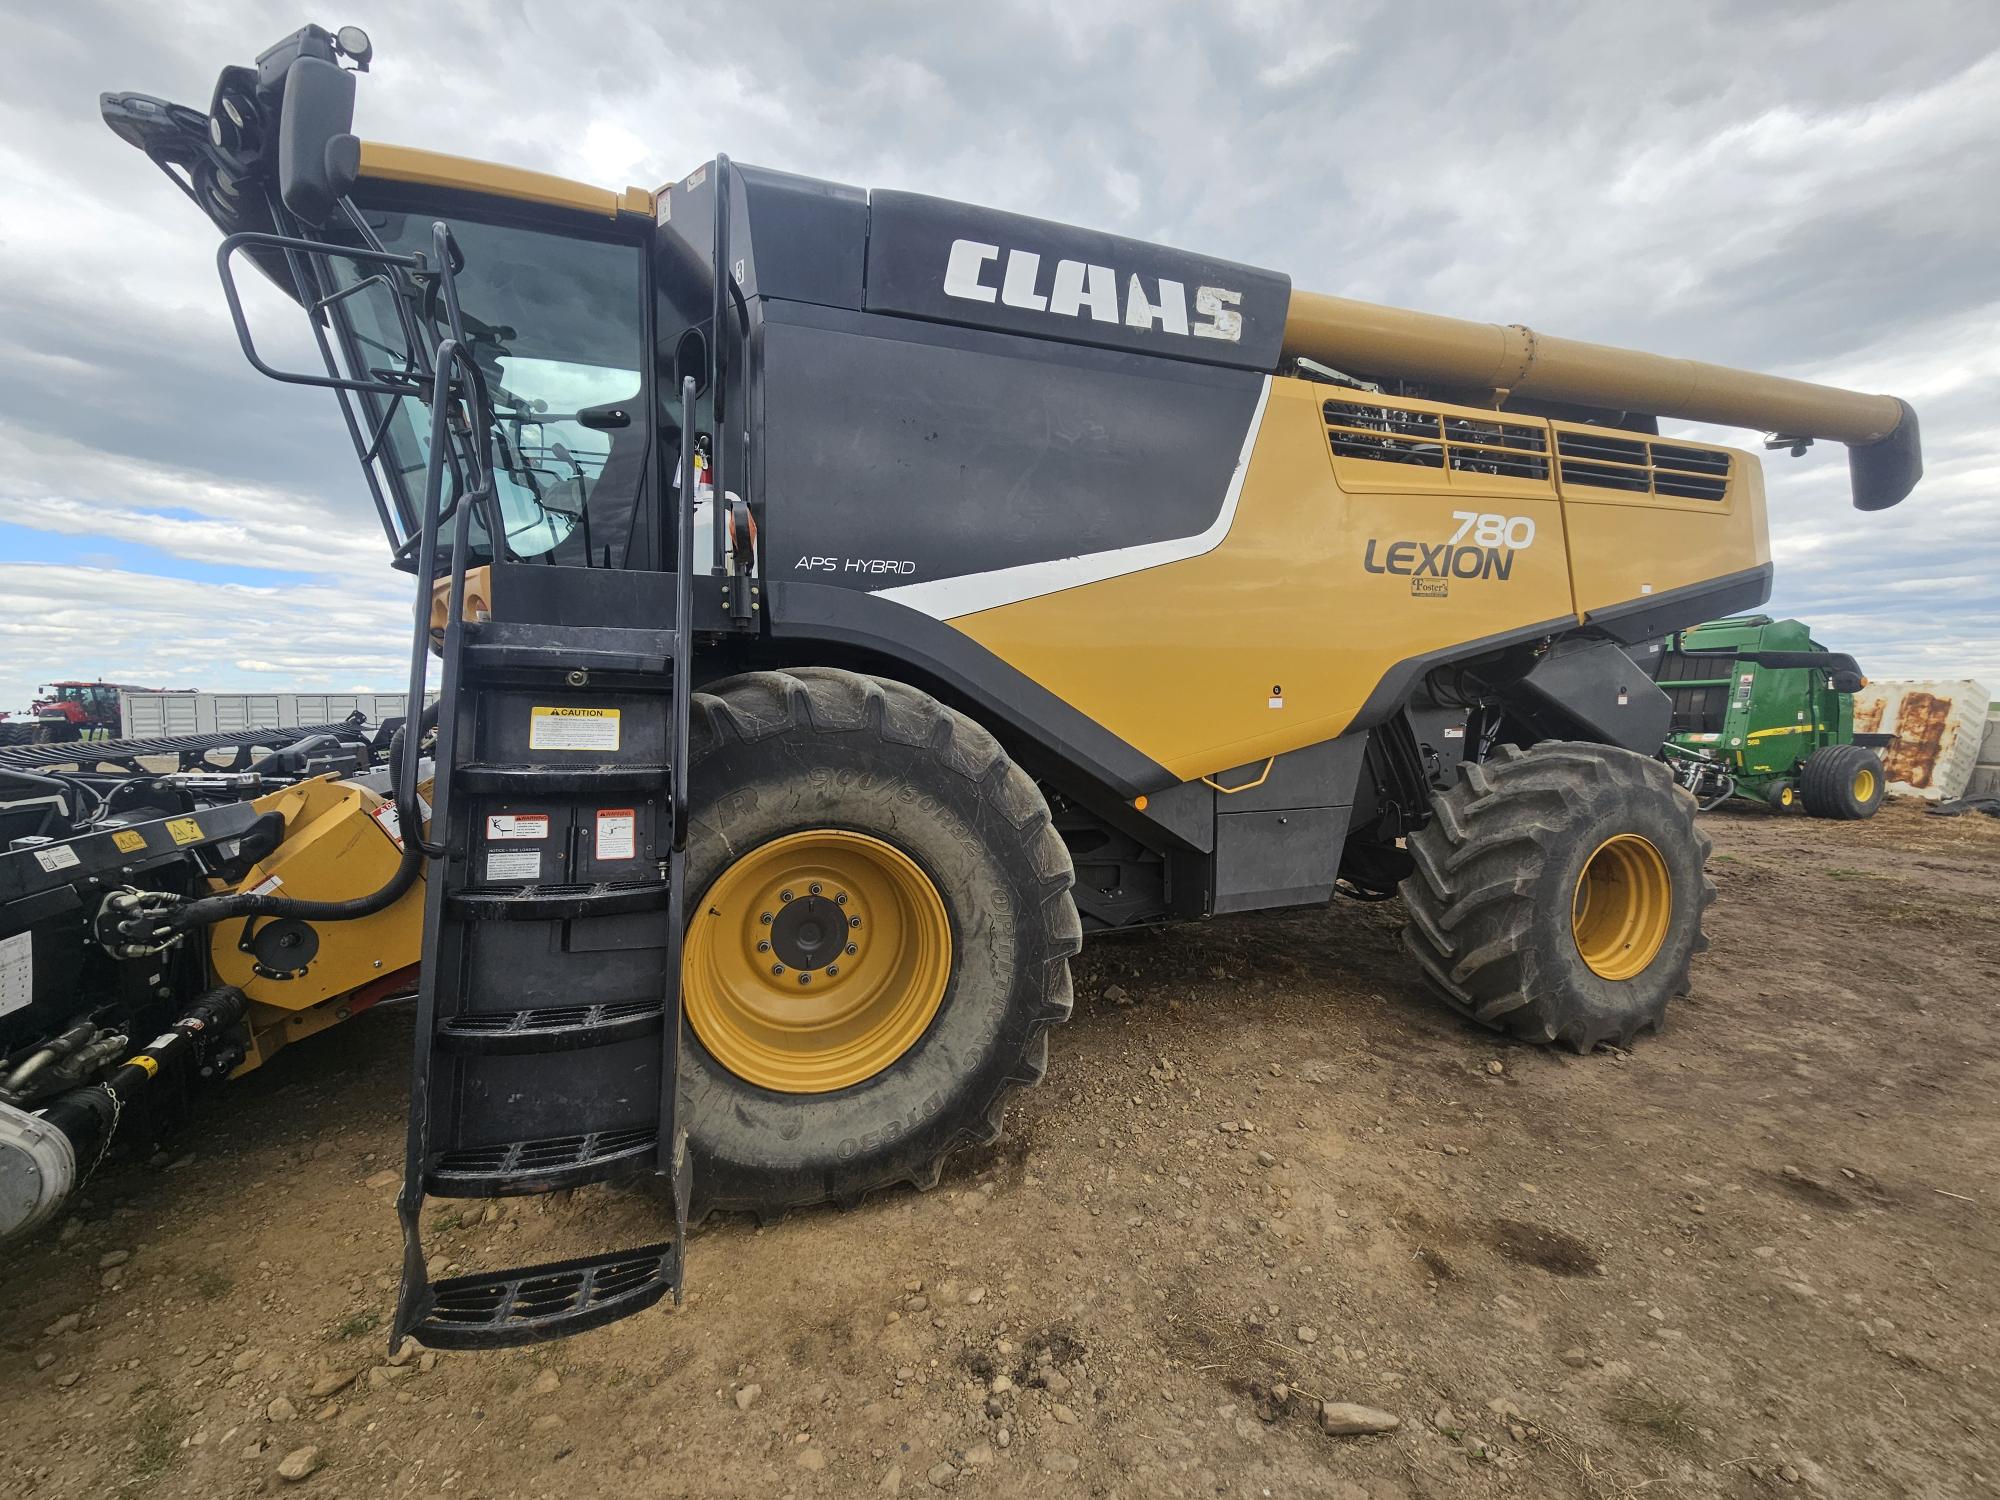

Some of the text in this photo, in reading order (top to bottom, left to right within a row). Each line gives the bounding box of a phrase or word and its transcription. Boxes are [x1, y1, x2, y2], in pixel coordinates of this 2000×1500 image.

[1449, 511, 1536, 550] 780
[795, 556, 916, 574] APS HYBRID
[1364, 539, 1515, 581] LEXION
[561, 709, 603, 717] CAUTION
